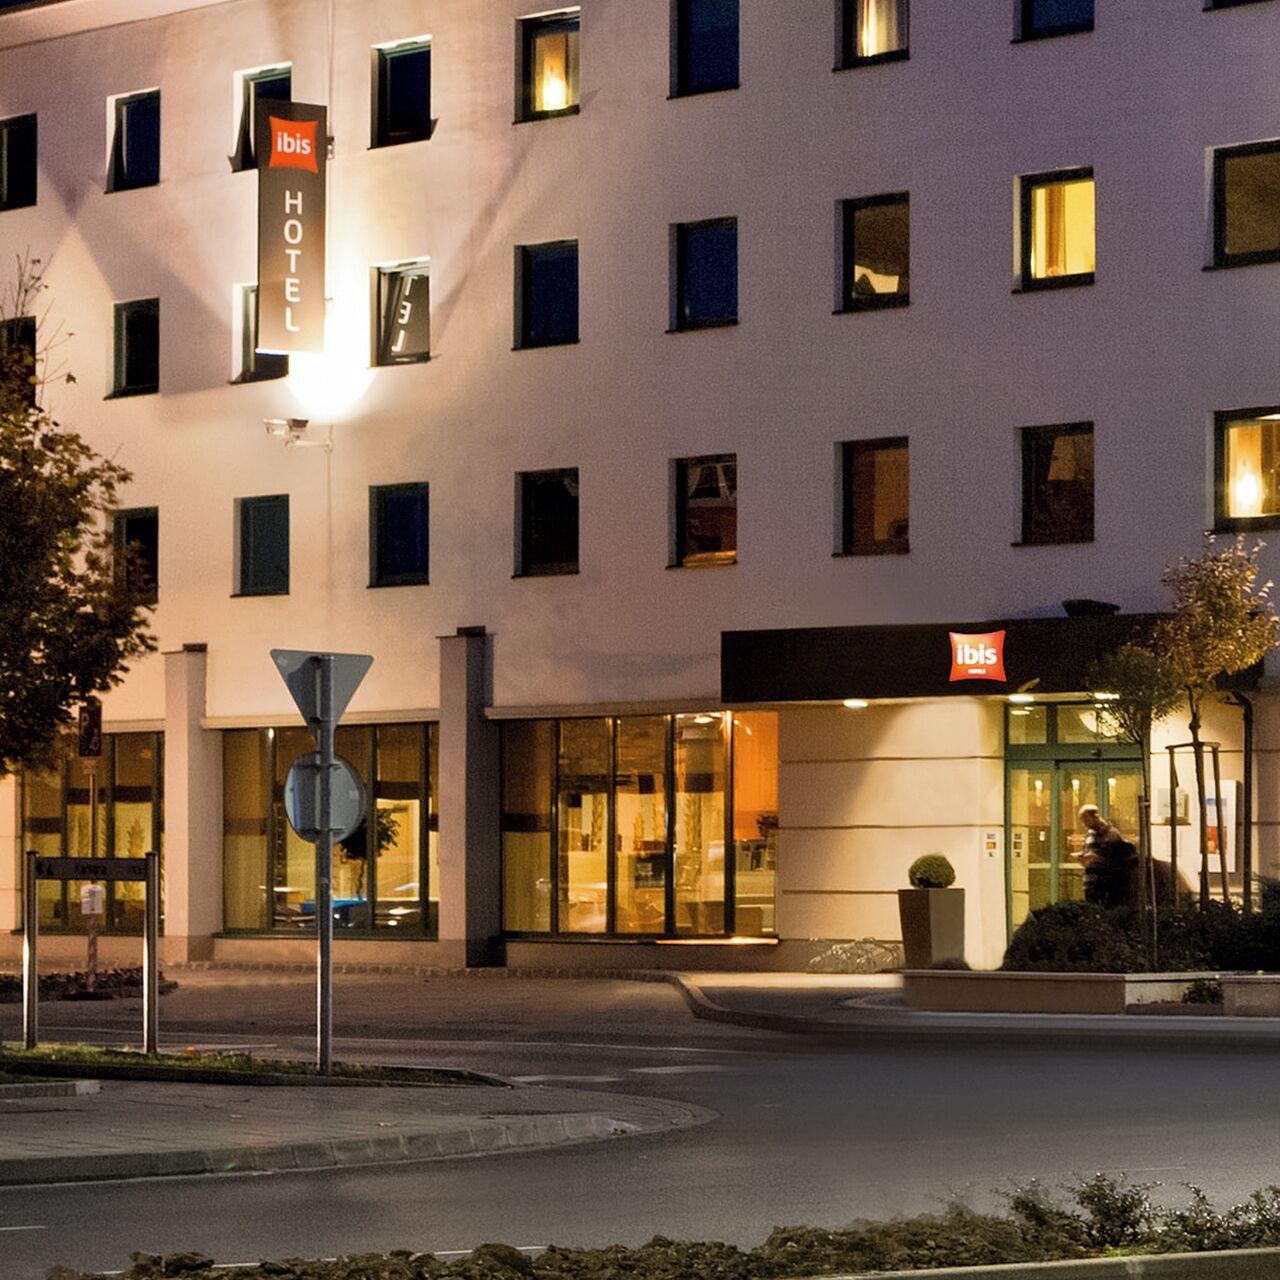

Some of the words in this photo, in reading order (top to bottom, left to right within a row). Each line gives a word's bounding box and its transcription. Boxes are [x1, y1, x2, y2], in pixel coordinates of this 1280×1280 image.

[276, 131, 311, 155] ibis
[284, 189, 302, 333] HOTEL
[957, 643, 998, 665] ibis
